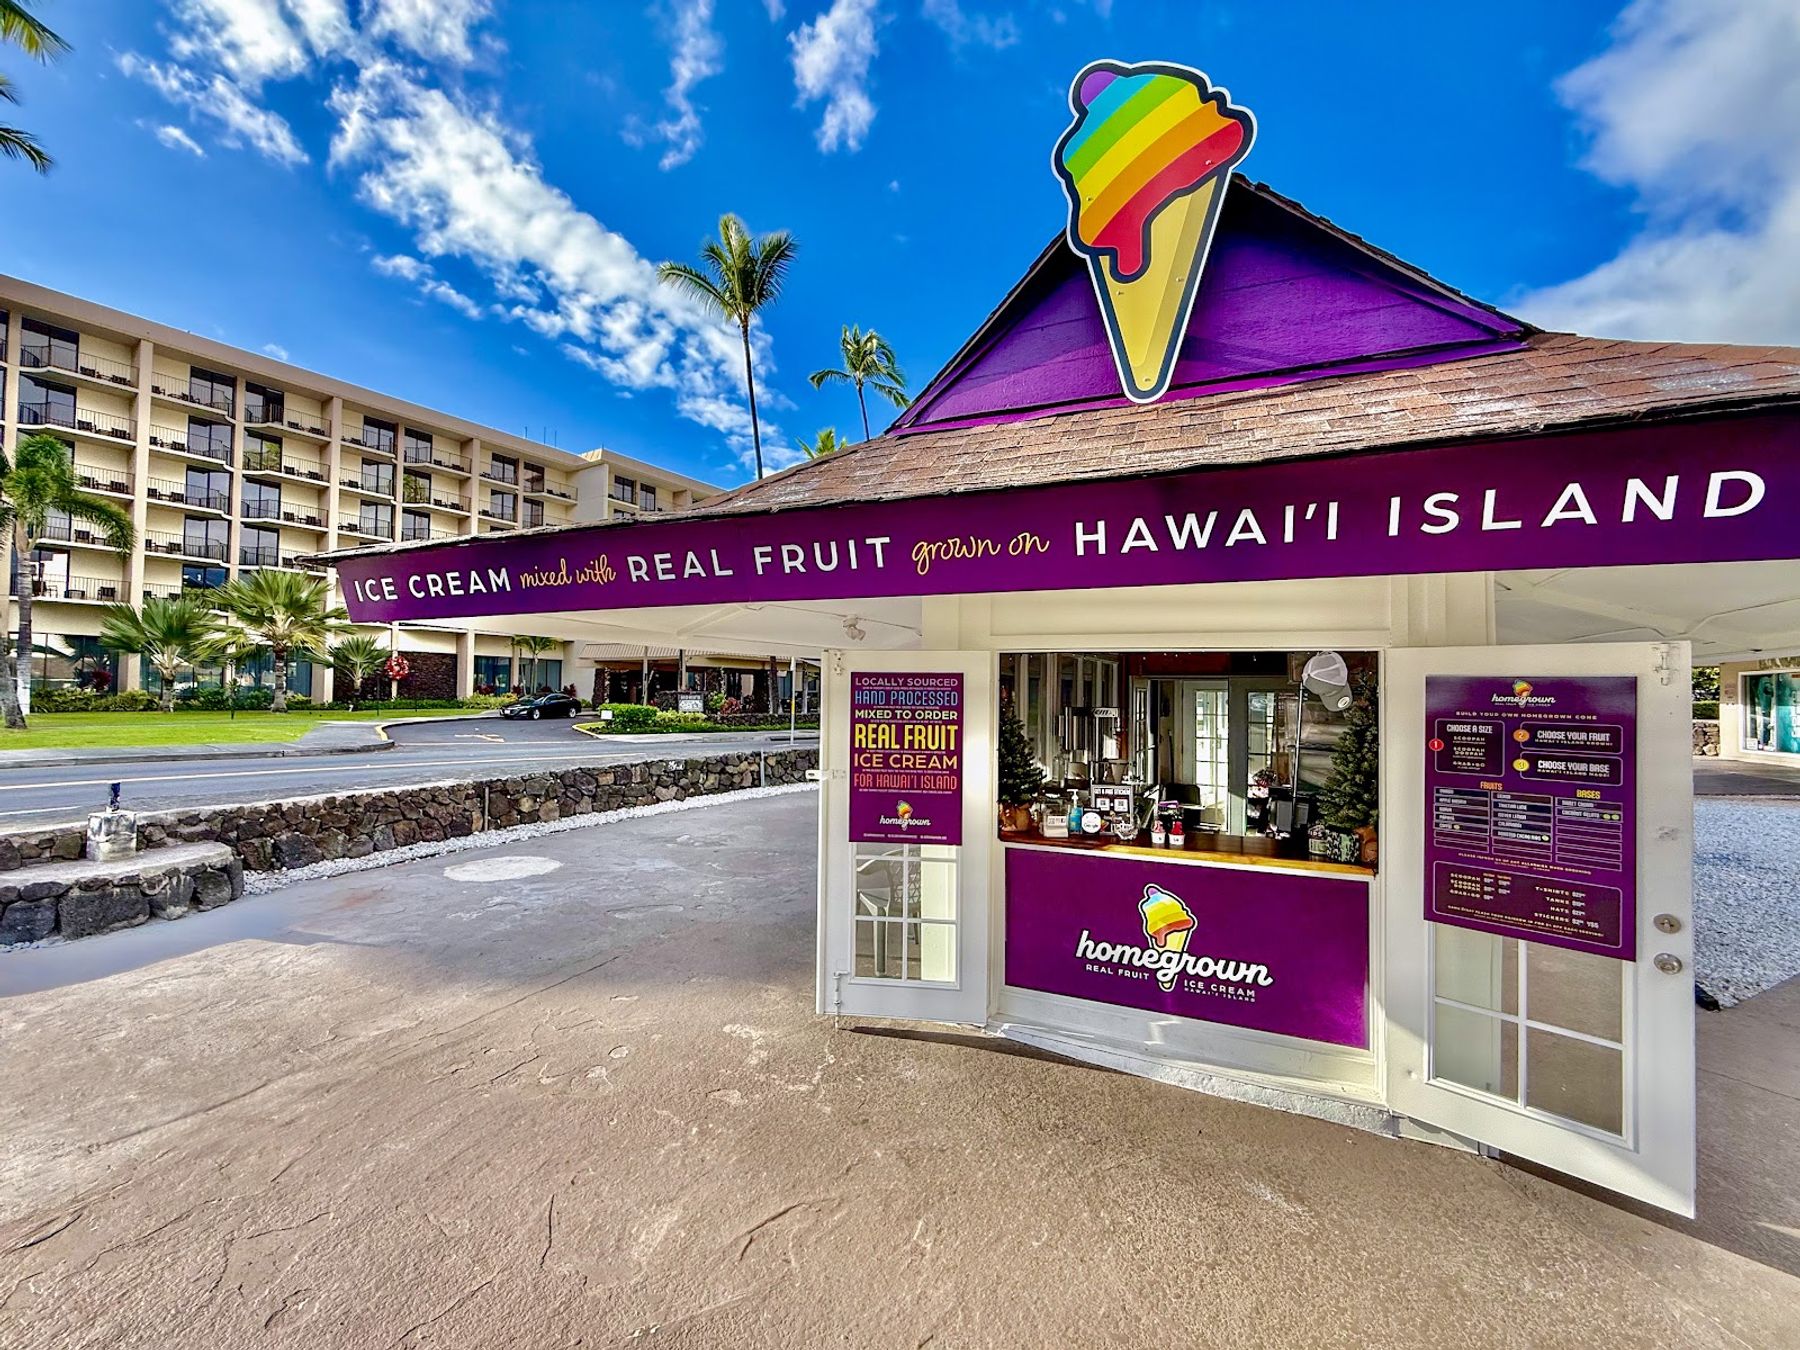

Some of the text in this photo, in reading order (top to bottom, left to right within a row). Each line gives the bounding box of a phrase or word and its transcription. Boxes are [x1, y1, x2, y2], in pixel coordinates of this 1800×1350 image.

[354, 470, 1766, 602] ICE CREAM mixed with REAL FRUIT grown on HAWAI'I ISLAND
[855, 677, 958, 687] LOCALLY SOURCED
[855, 690, 958, 706] HAND PROCESSED
[1491, 693, 1556, 707] homegrown
[855, 709, 958, 720] MIXED TO ORDER
[1446, 723, 1493, 734] CHOOSE A SIZE
[854, 723, 958, 750] REAL FRUIT
[1537, 730, 1611, 742] CHOOSE YOUR FRUIT
[1433, 740, 1438, 749] 1
[854, 753, 958, 770] ICE CREAM
[1537, 760, 1610, 773] CHOOSE YOUR BASE
[854, 773, 957, 790] FOR HAWAI'I ISLAND
[1480, 781, 1503, 791] FRUITS
[1576, 789, 1601, 800] BASES
[879, 815, 931, 828] homegrown
[1450, 872, 1480, 881] SCOOPAH
[1535, 886, 1569, 896] T-SHIRTS
[1545, 896, 1569, 905] TANKS
[1550, 906, 1569, 914] HATS
[1534, 912, 1569, 922] STICKERS
[1075, 930, 1274, 987] homegrown
[1086, 964, 1150, 980] REAL FRUIT
[1184, 979, 1256, 997] ICE CREAM
[1222, 992, 1256, 1003] ISLAND
